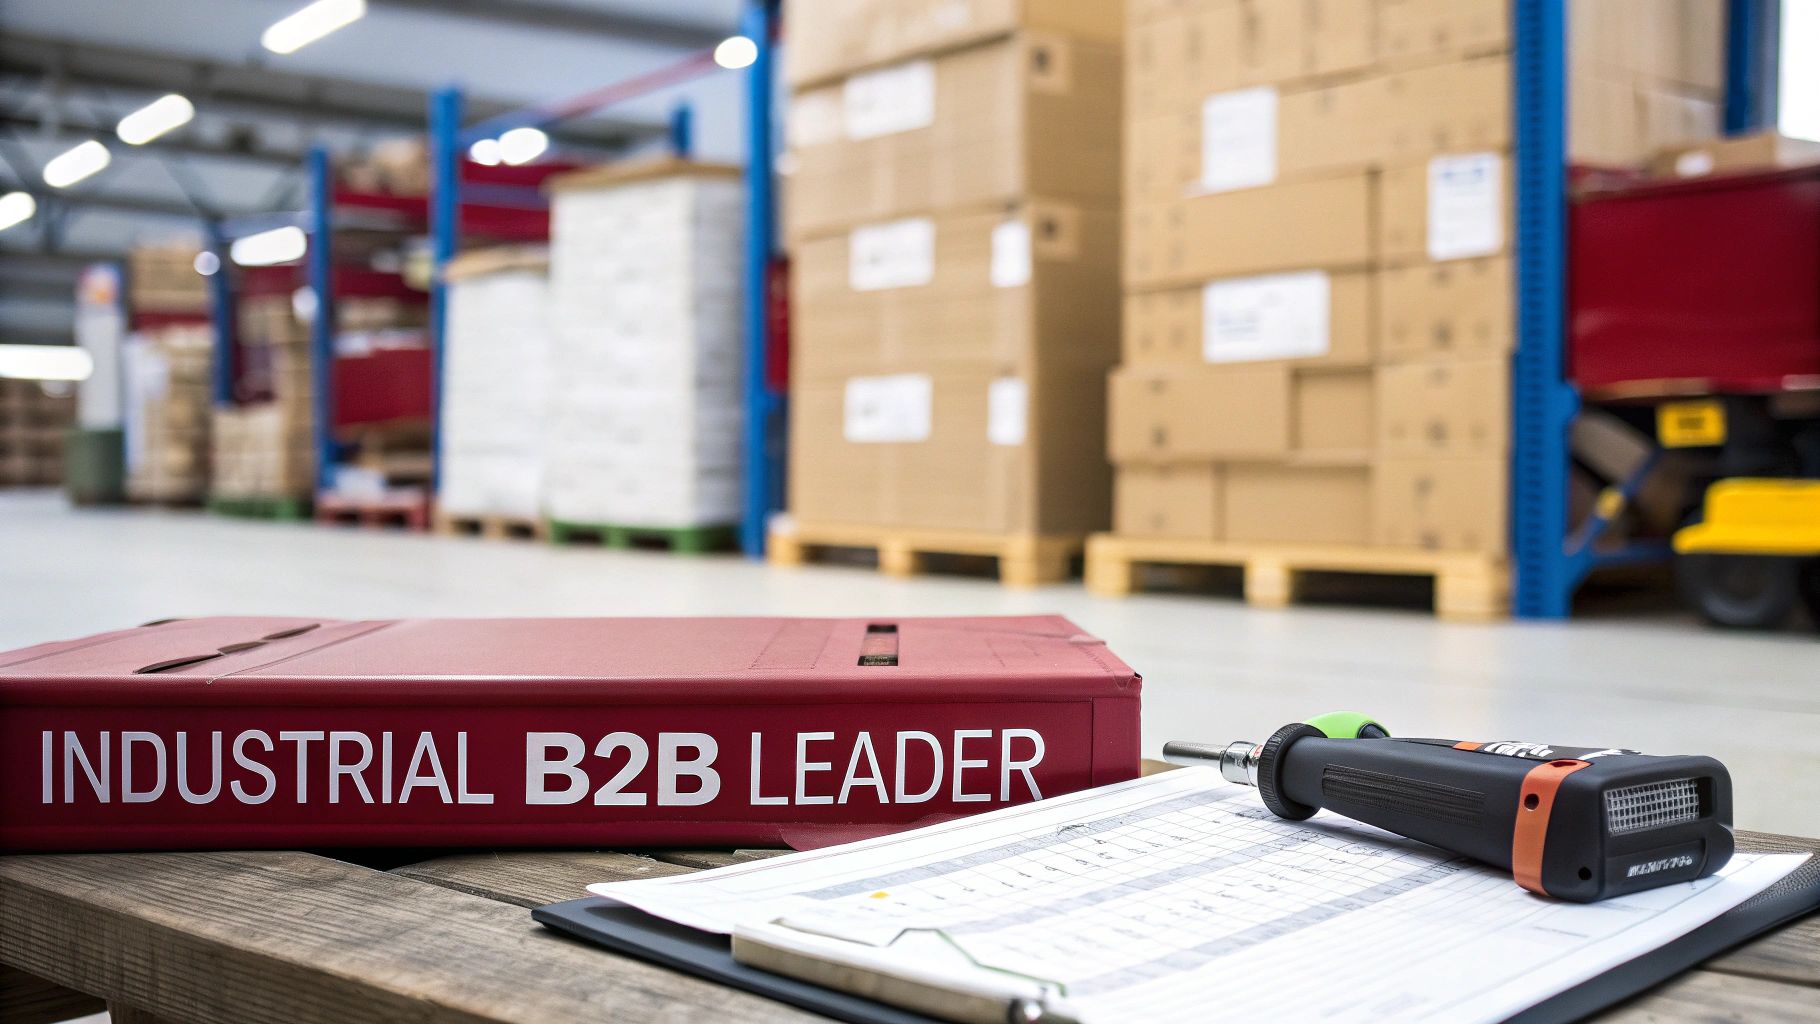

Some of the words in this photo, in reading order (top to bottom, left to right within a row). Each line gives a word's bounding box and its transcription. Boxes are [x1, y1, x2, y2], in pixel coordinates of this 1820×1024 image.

[42, 730, 494, 805] INDUSTRIAL
[525, 731, 720, 806] B2B
[750, 728, 1046, 806] LEADER
